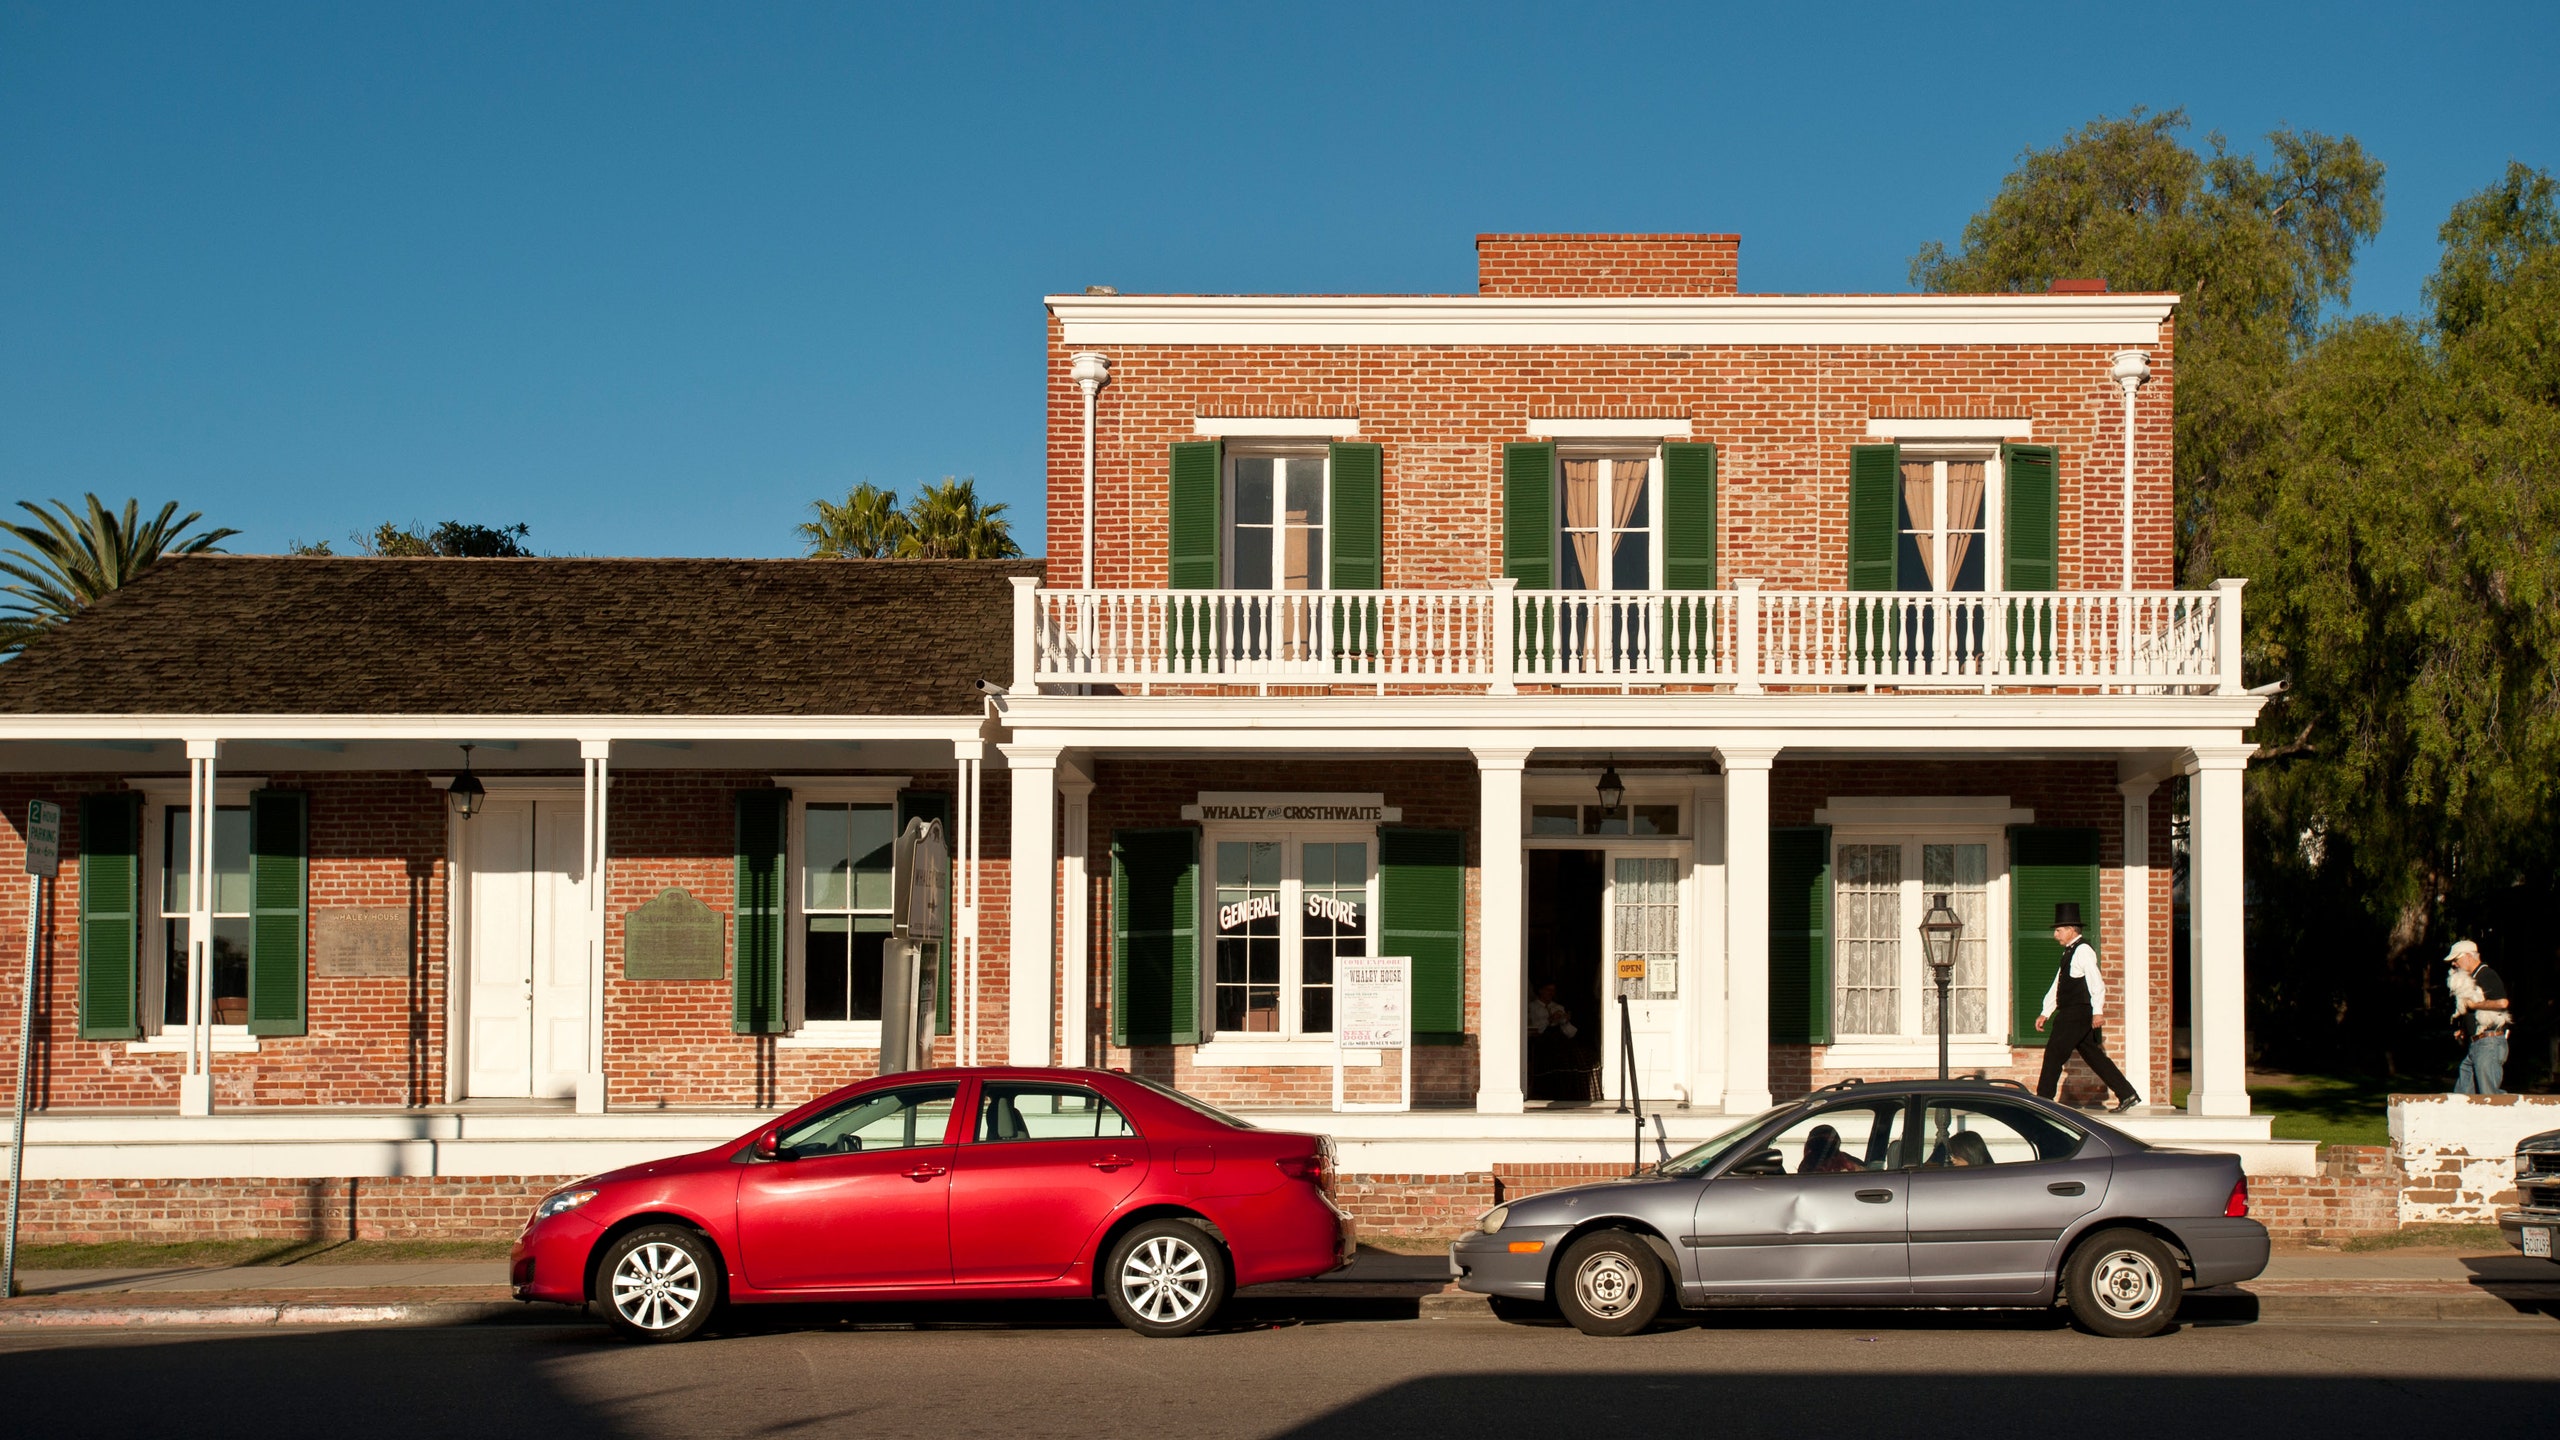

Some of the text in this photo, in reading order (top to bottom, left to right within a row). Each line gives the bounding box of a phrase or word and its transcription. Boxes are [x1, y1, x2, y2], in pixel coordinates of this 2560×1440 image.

[31, 804, 57, 823] 2 HOUR
[1202, 806, 1382, 820] WHALEY AND CROSTHWAITE
[30, 826, 57, 843] PARKING
[333, 913, 400, 921] WHALEY HOUSE
[1219, 893, 1358, 930] GENERAL STORE
[1620, 964, 1642, 972] OPEN
[1350, 970, 1378, 982] WHALEY
[1380, 970, 1402, 982] HOUSE
[621, 1231, 667, 1251] EAGLE
